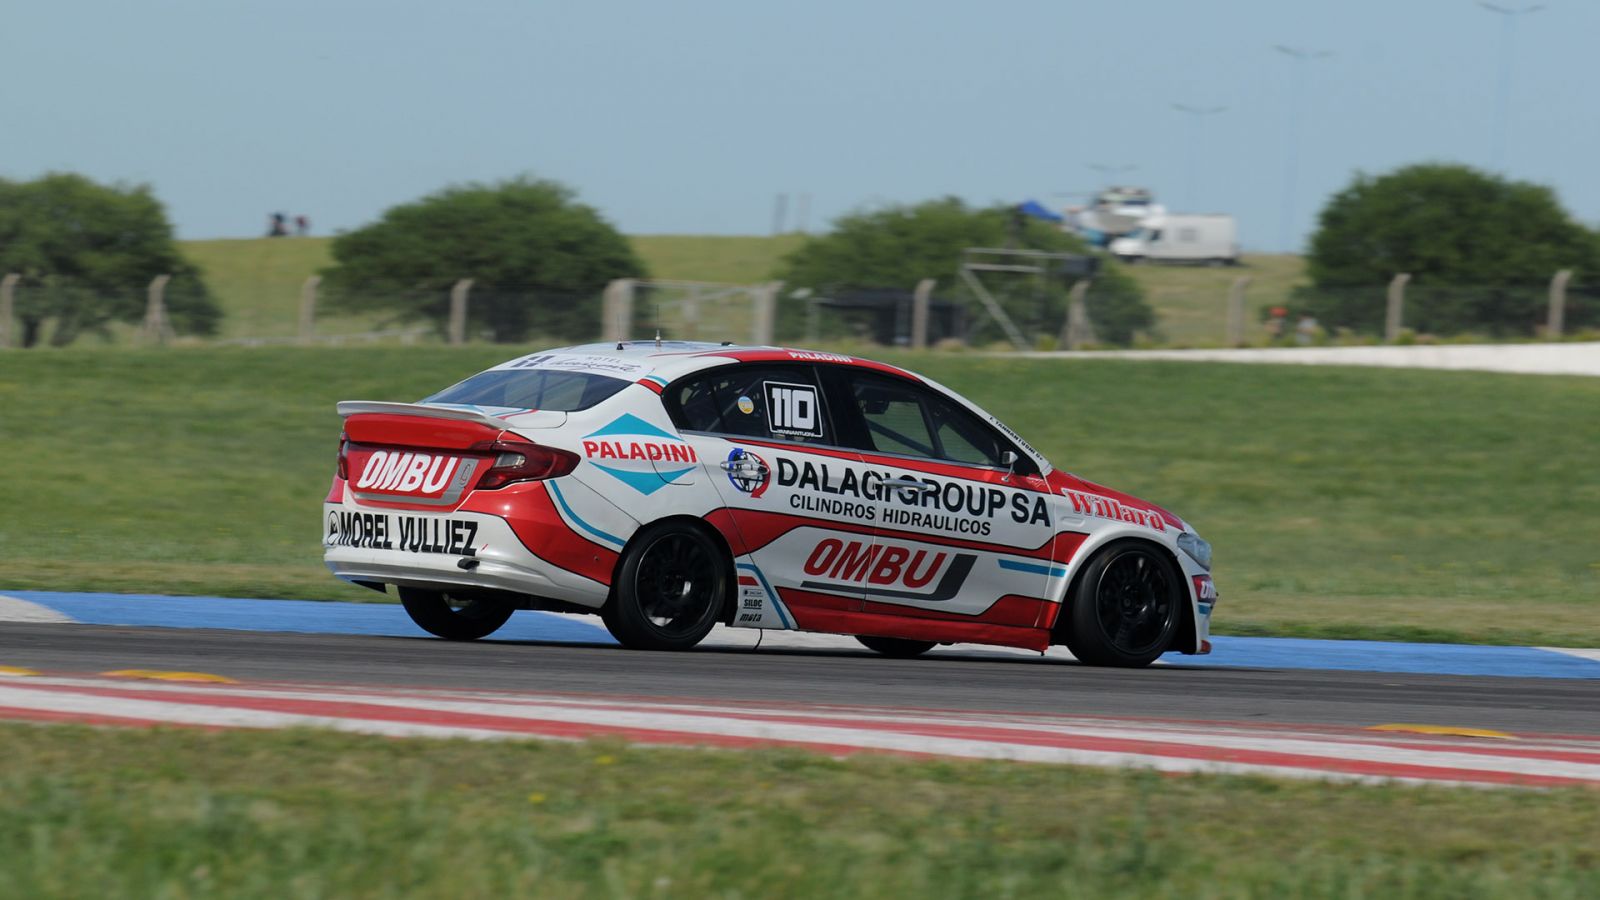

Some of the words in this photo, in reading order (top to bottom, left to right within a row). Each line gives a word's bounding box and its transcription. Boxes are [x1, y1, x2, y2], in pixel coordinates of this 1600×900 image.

[787, 352, 853, 363] PALADINI
[772, 387, 815, 430] 110
[357, 451, 458, 493] OMBU
[582, 441, 697, 463] PALADINI
[776, 457, 891, 503] DALAGI
[897, 474, 1006, 518] GROUP
[1011, 493, 1051, 527] SA
[1065, 489, 1166, 532] Willard
[338, 512, 393, 550] MOREL
[399, 516, 479, 557] VULLIEZ
[790, 494, 875, 520] CILINDROS
[882, 508, 991, 536] HIDRAULICOS
[803, 538, 947, 588] OMBU
